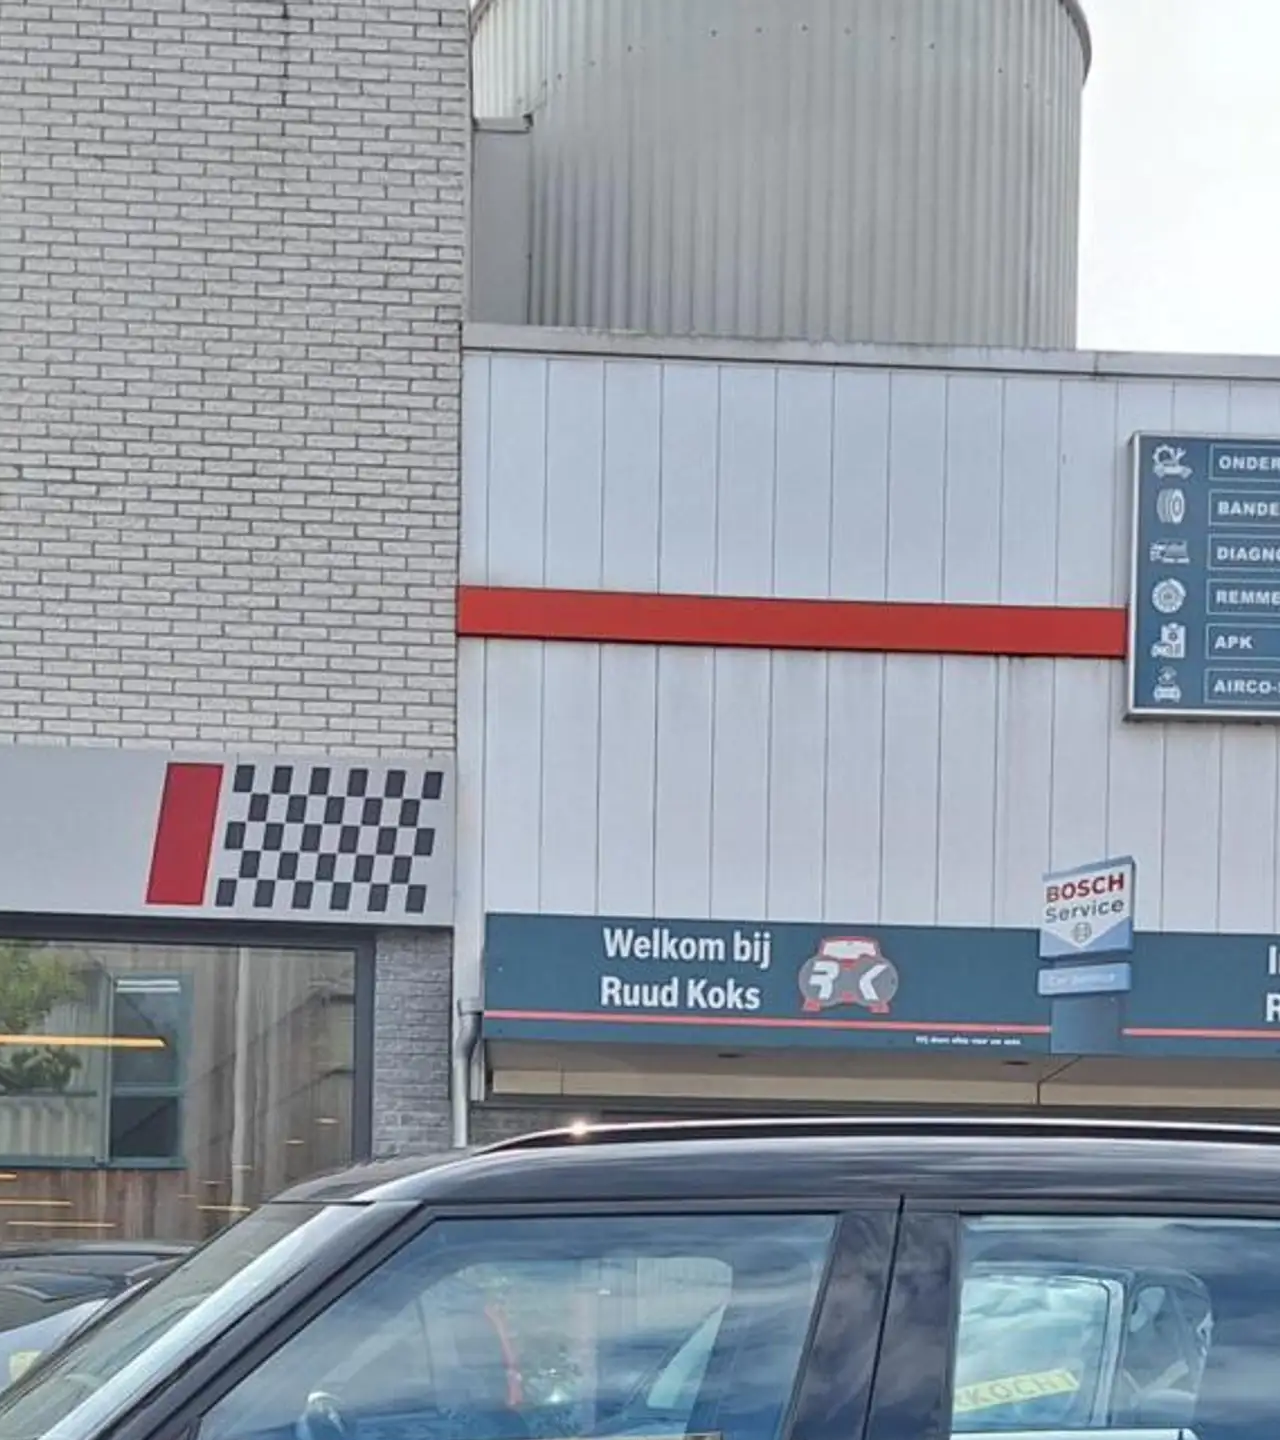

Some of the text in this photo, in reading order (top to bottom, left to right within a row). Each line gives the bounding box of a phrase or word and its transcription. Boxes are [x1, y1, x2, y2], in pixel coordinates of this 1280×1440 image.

[1214, 635, 1253, 650] APK
[1046, 872, 1125, 904] BOSCH
[1045, 899, 1125, 924] Service
[603, 927, 771, 969] Welkom bij
[600, 975, 761, 1010] Ruud Koks
